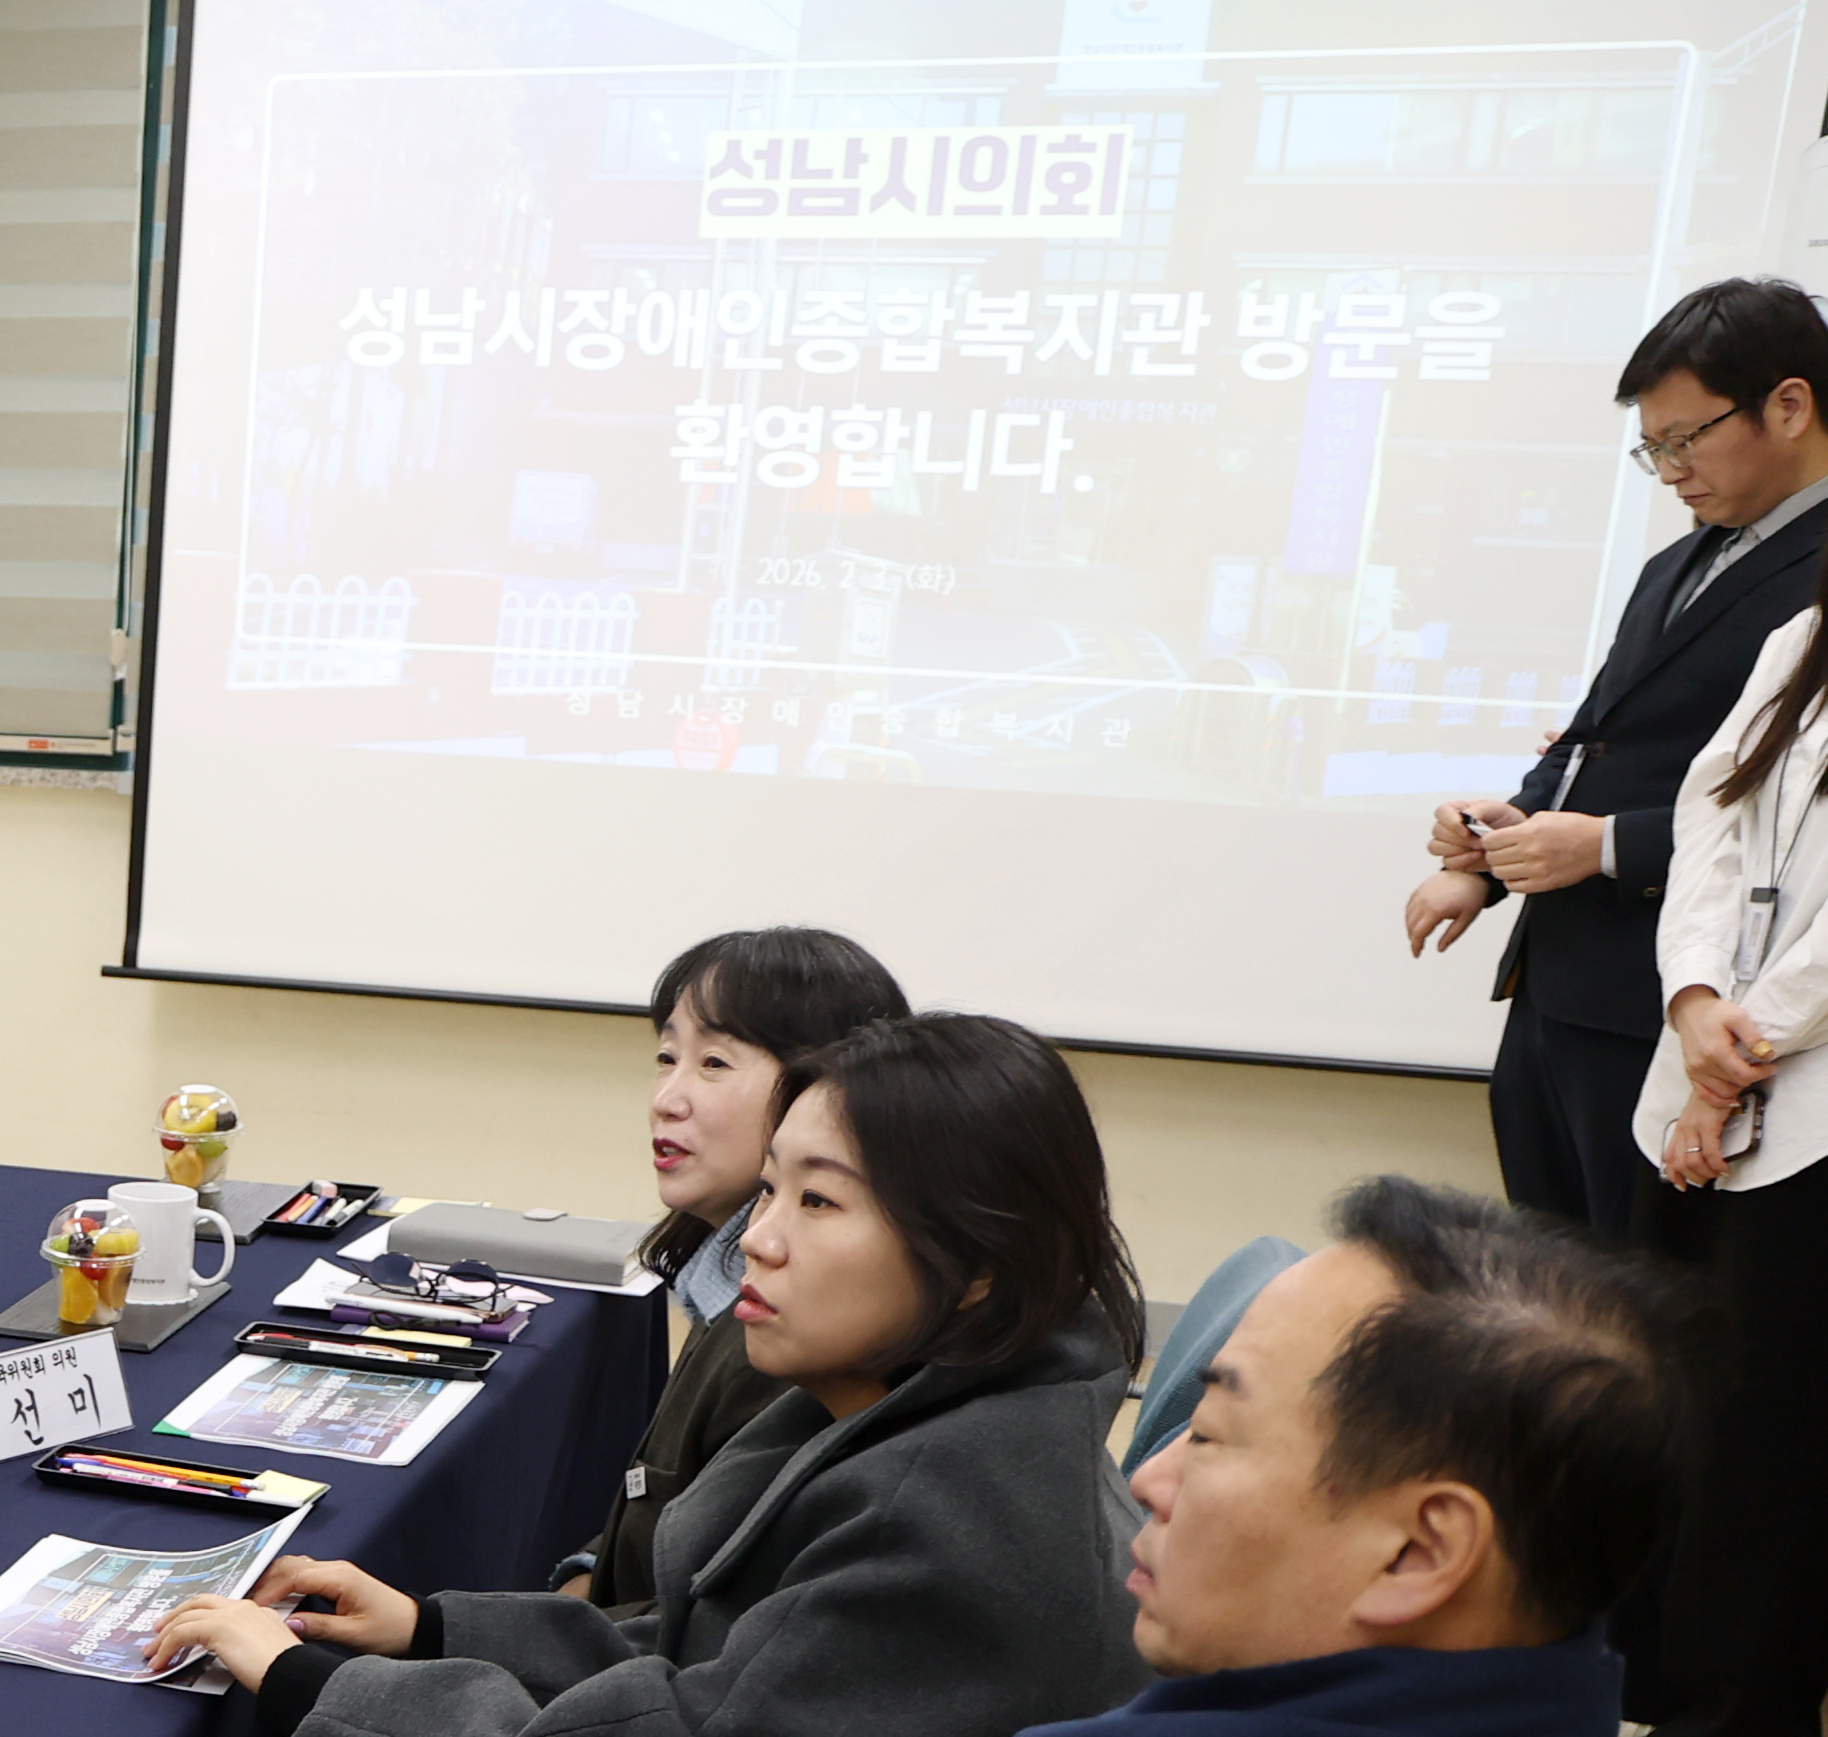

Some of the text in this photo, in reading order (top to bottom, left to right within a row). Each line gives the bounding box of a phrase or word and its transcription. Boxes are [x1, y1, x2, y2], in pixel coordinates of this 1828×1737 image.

[705, 131, 1124, 220] 성남시의회
[337, 286, 1505, 383] 성남시장애인종합복지관 방문을
[670, 397, 1096, 496] 환영합니다.
[52, 1346, 78, 1371] 의원
